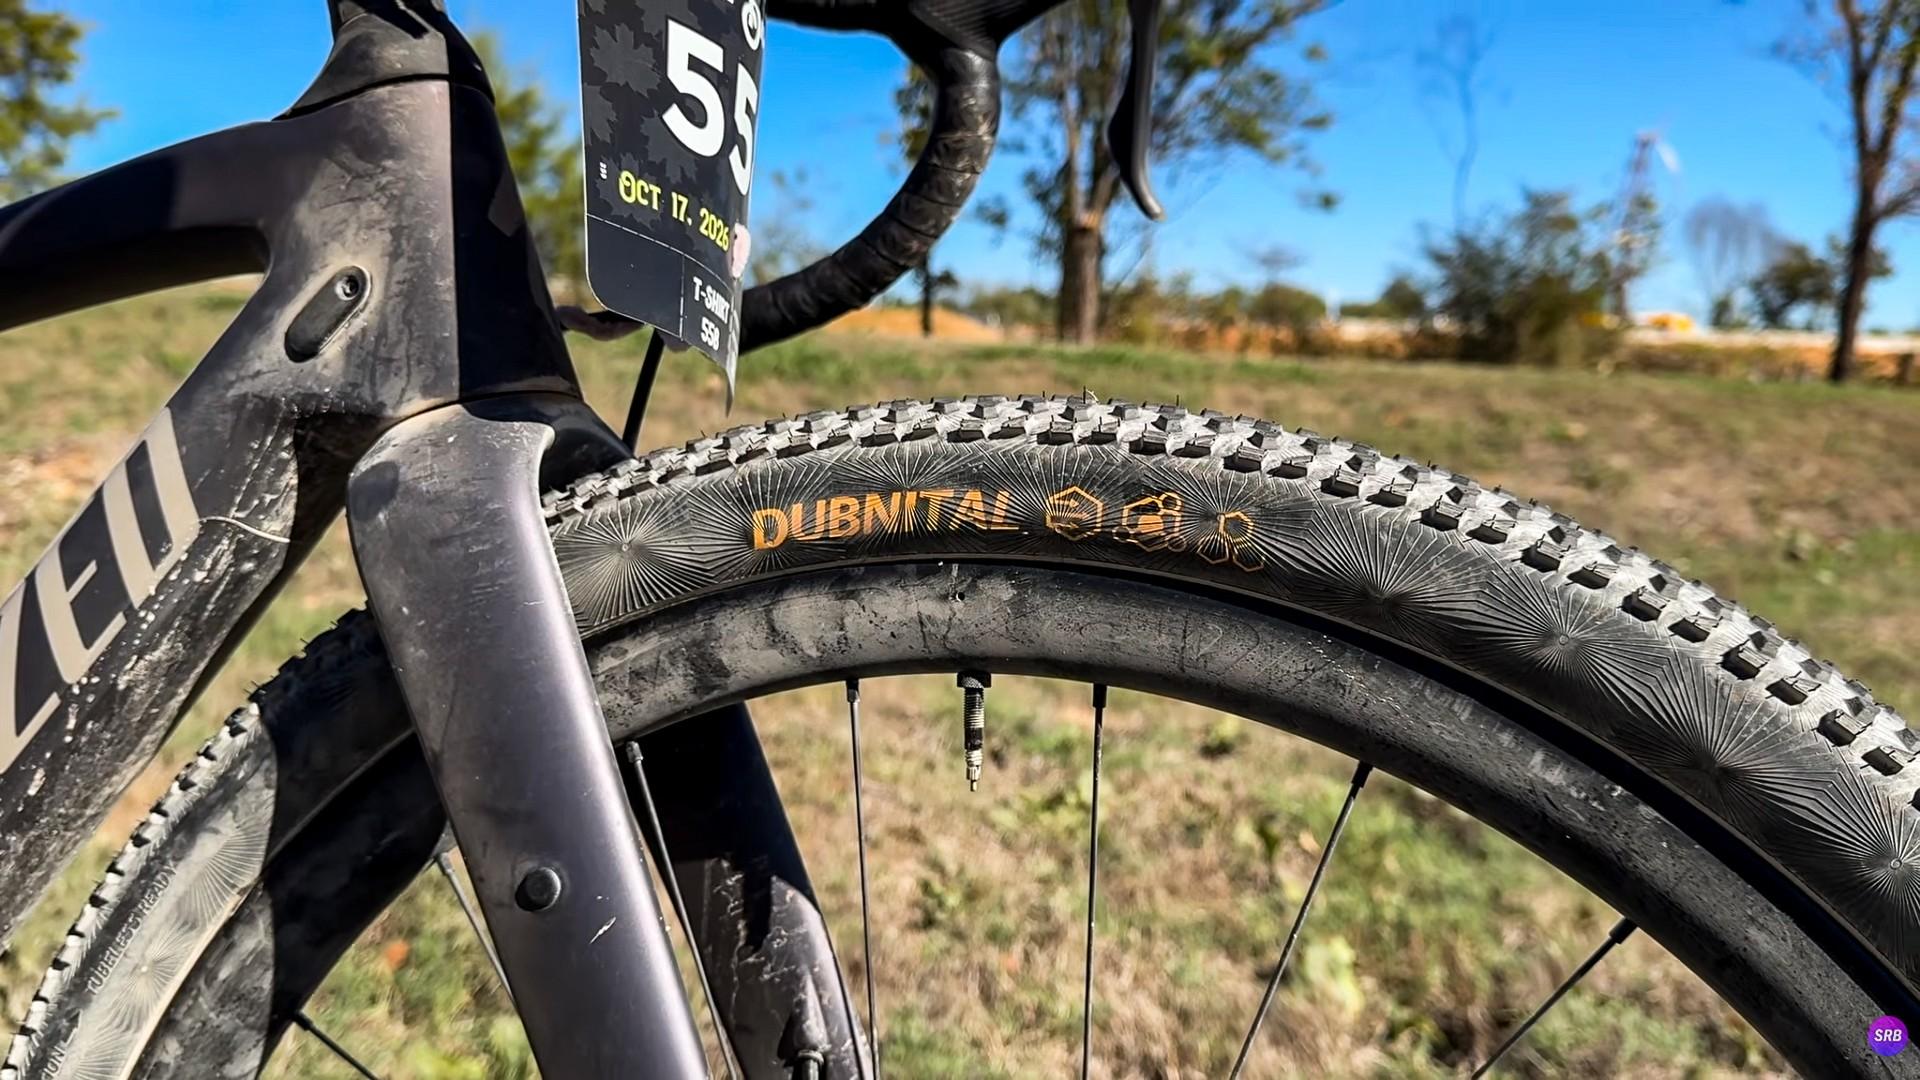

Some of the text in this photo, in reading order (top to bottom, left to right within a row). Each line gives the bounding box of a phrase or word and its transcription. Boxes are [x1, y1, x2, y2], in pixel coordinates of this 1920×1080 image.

[618, 170, 662, 211] OCT
[698, 207, 731, 252] 2026
[692, 276, 731, 325] T-SHIRT
[700, 317, 720, 351] 558
[752, 488, 1021, 551] DUBNITAL
[85, 862, 180, 996] TUBELESS READY
